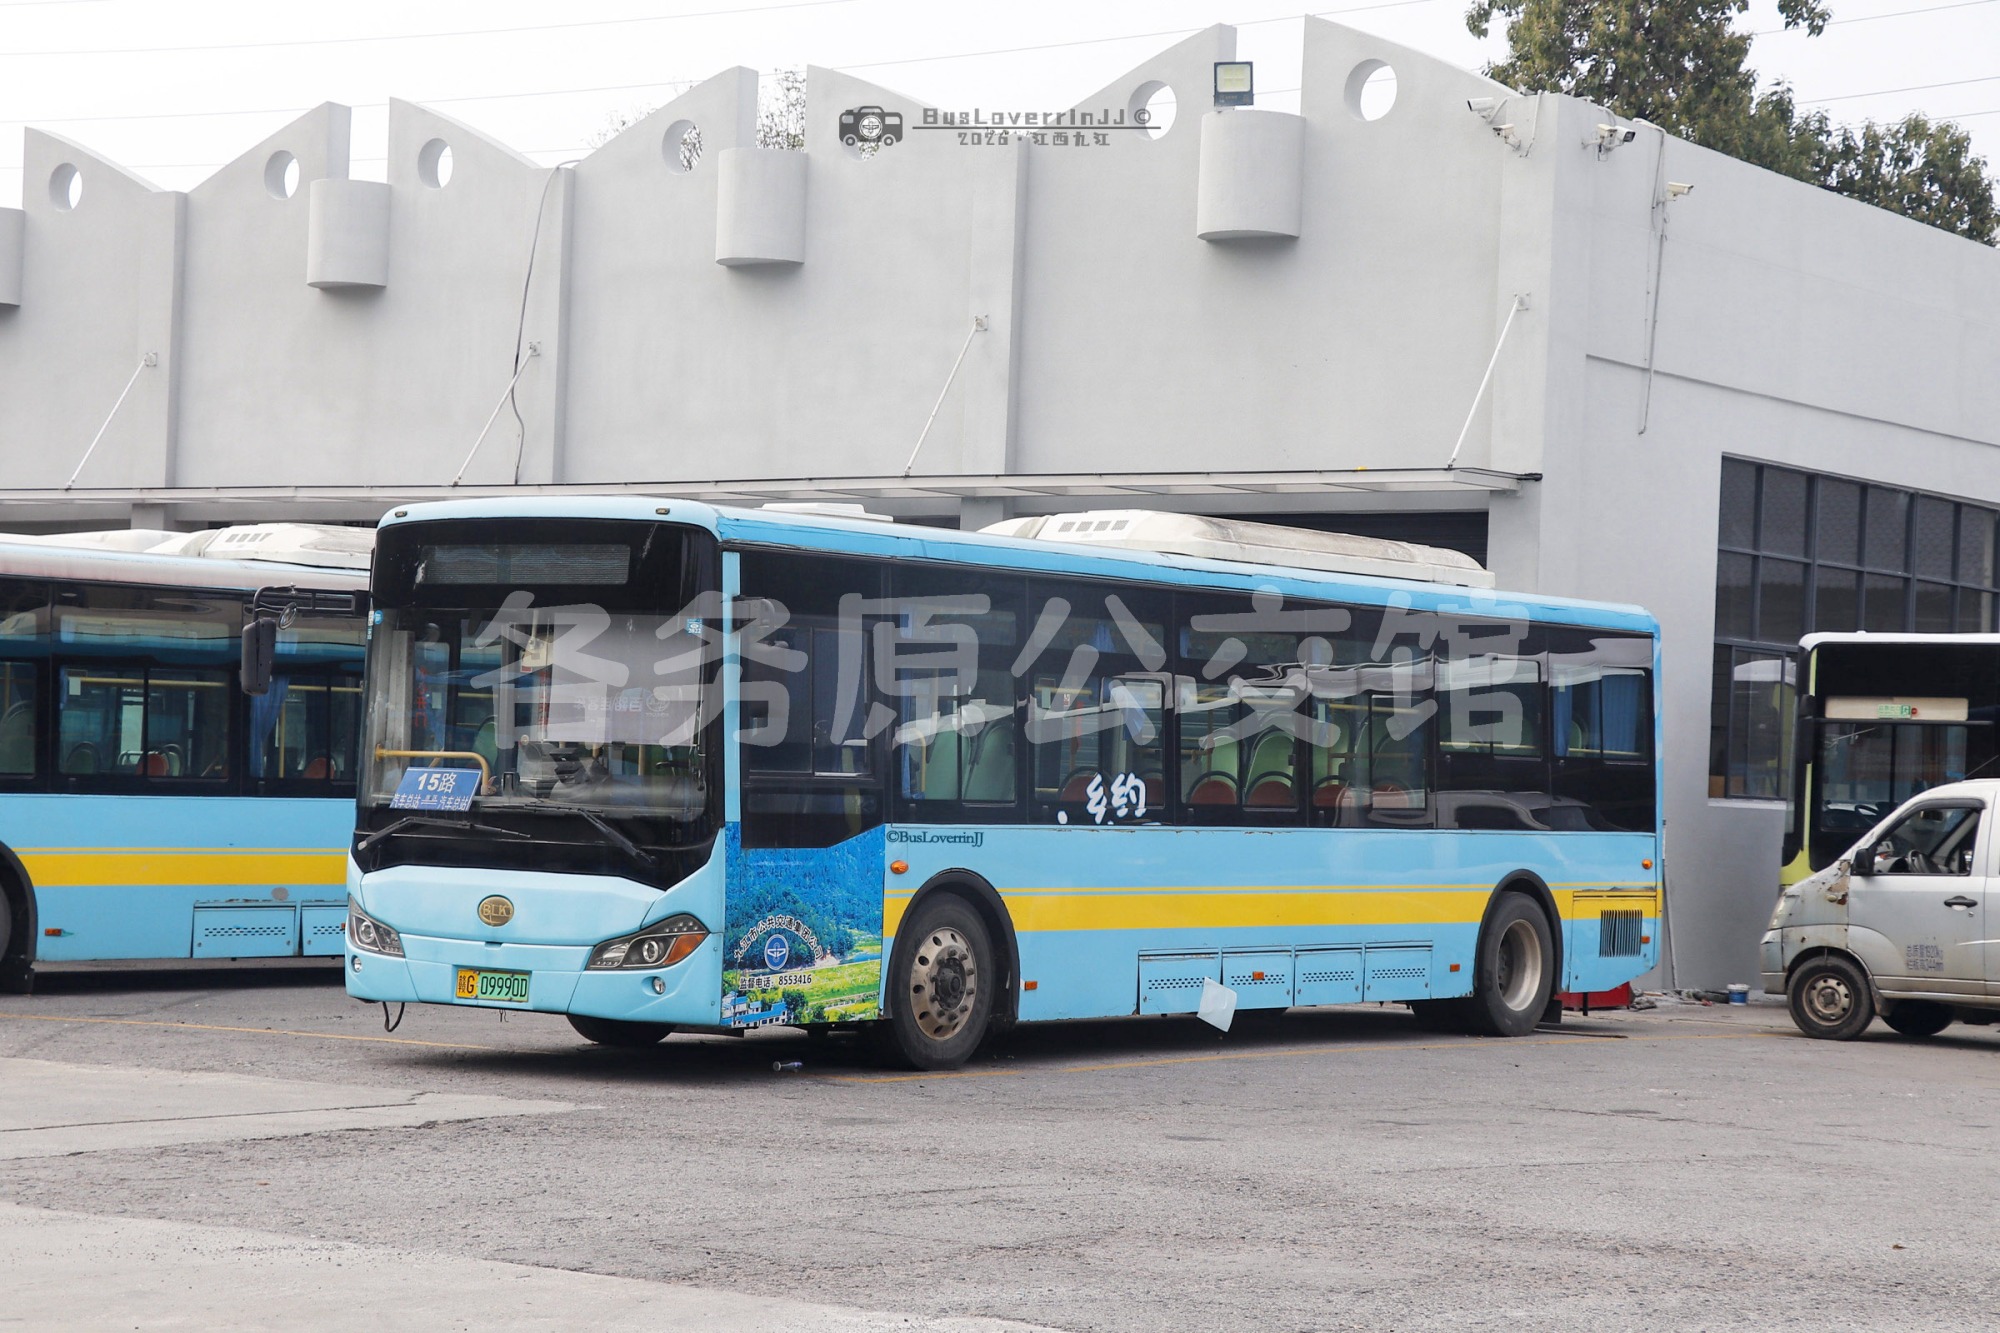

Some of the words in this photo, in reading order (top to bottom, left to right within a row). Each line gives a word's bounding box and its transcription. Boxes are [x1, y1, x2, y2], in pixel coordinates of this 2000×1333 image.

[417, 772, 457, 793] 15路
[391, 793, 421, 809] 汽车总站
[437, 796, 470, 810] 汽车总站
[734, 914, 824, 960] 九江市公共交通集团公司
[778, 974, 812, 986] 8553416
